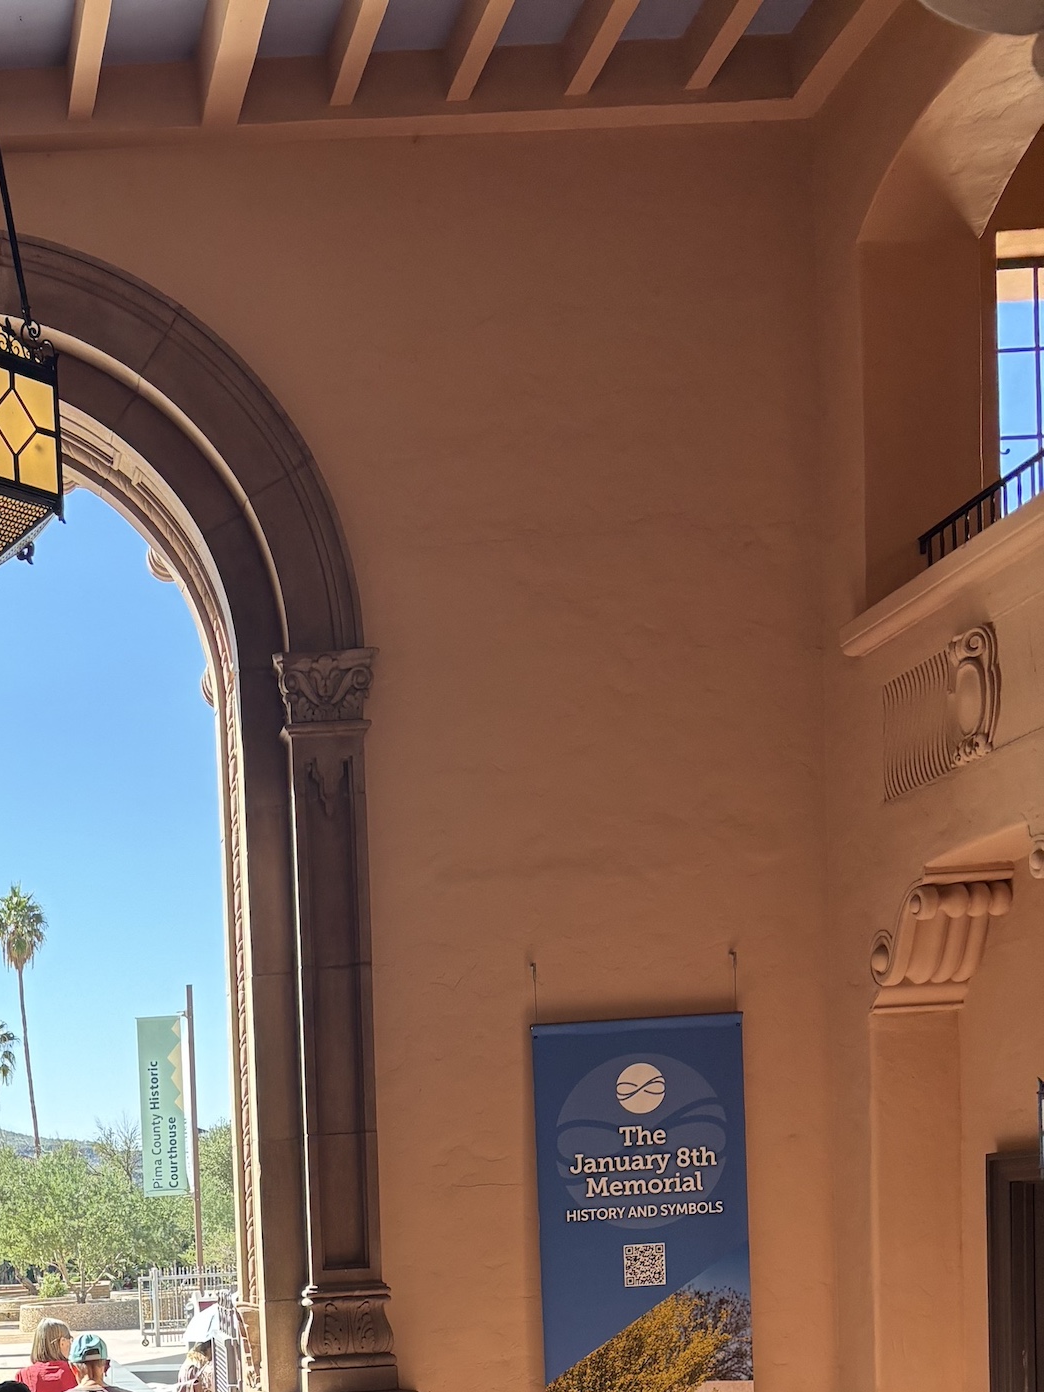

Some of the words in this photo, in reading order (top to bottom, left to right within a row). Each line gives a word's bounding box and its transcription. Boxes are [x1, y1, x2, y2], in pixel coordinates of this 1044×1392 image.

[147, 1060, 160, 1110] Historic
[150, 1114, 164, 1155] County
[618, 1125, 667, 1147] The
[167, 1116, 179, 1188] Courthouse
[569, 1151, 671, 1175] January
[676, 1146, 718, 1168] 8th
[152, 1159, 163, 1189] Pima
[585, 1171, 704, 1198] Memorial
[566, 1206, 625, 1222] HISTORY
[628, 1204, 657, 1219] AND
[660, 1201, 724, 1216] SYMBOLS
